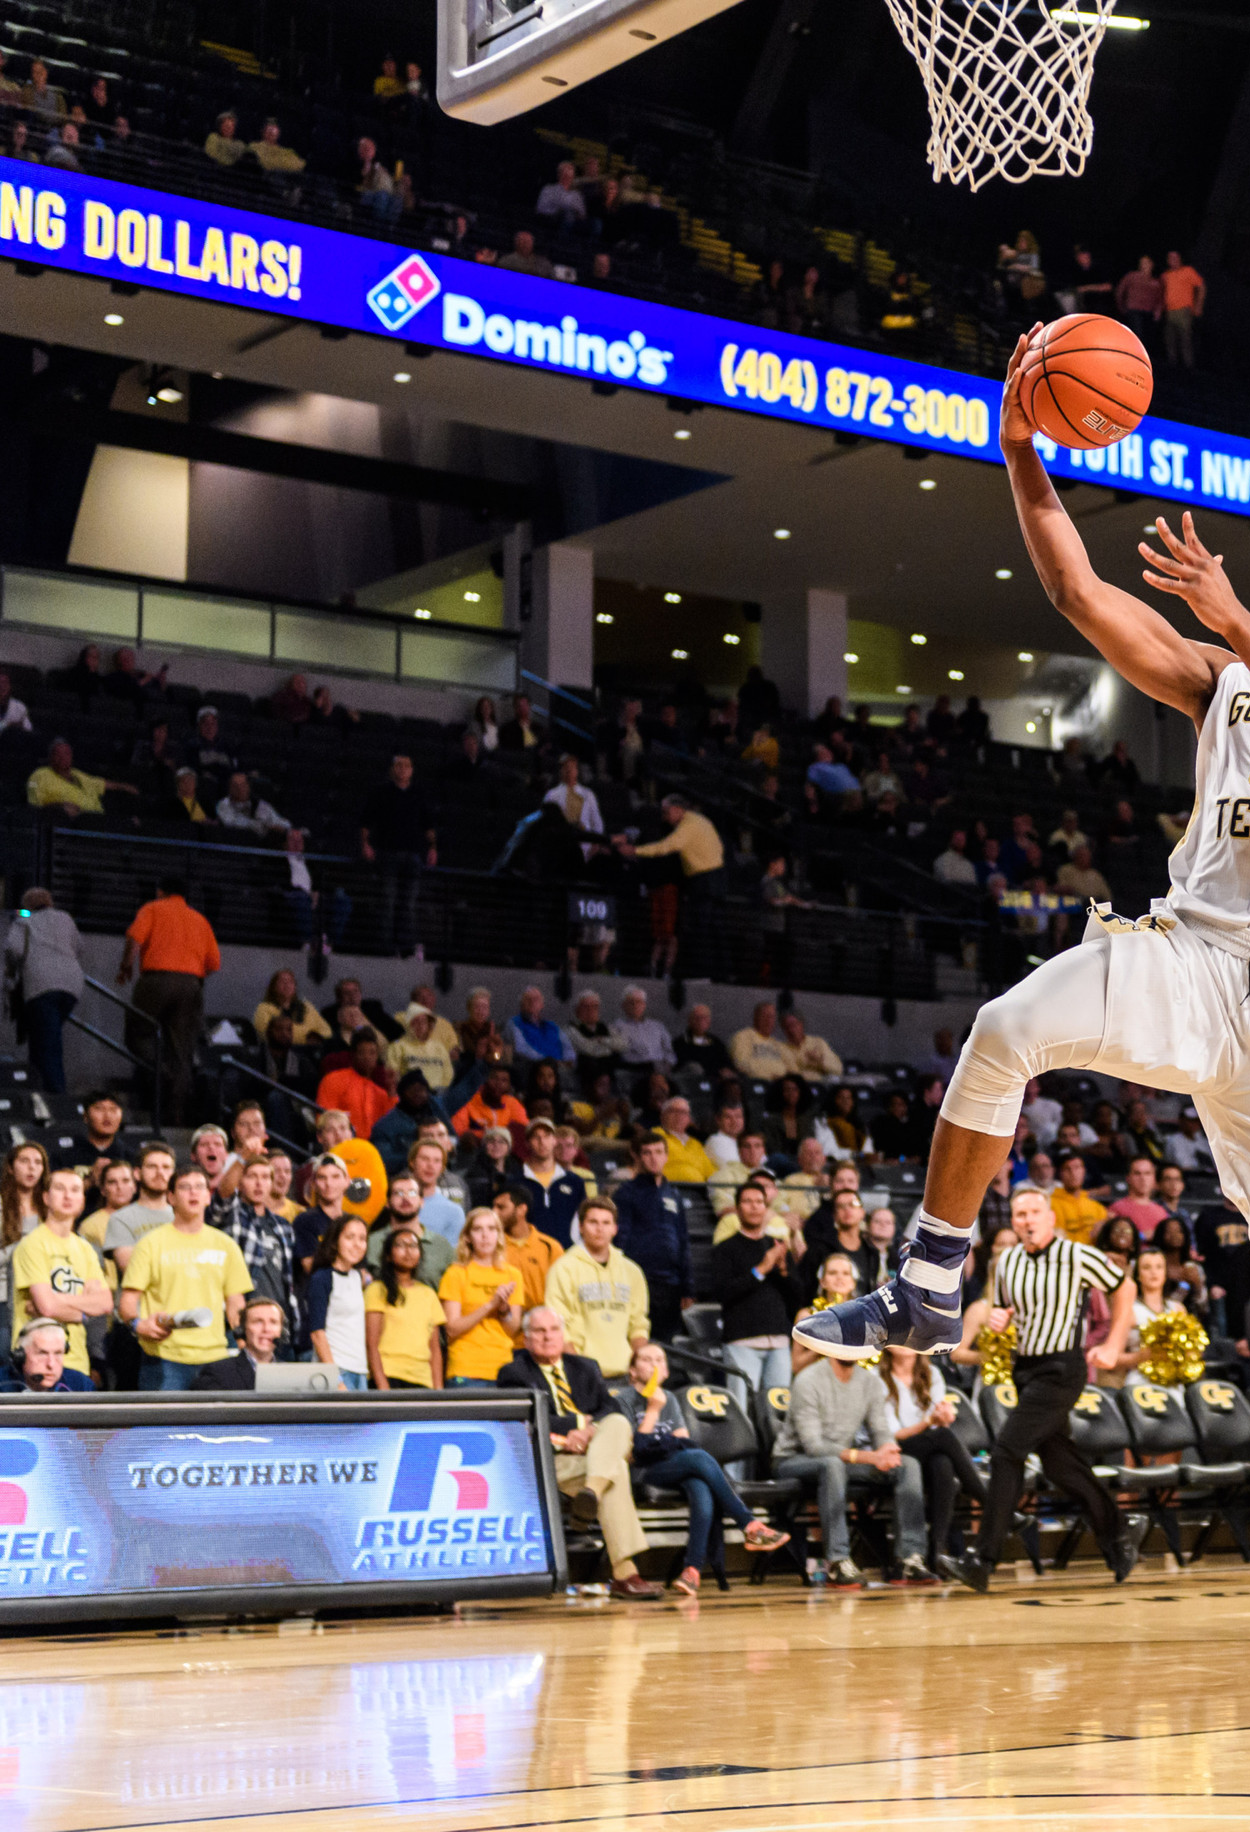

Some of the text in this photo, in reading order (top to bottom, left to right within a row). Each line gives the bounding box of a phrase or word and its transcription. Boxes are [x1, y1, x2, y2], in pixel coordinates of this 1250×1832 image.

[84, 200, 302, 300] DOLLARS!
[442, 293, 668, 386] Domino's
[720, 344, 990, 447] (404) 872-3000
[1149, 438, 1194, 492] ST.
[131, 1462, 378, 1489] TOGETHER WE
[0, 1530, 88, 1560] ELL
[357, 1516, 542, 1547] RUSSELL
[353, 1547, 542, 1570] ATHLETIC
